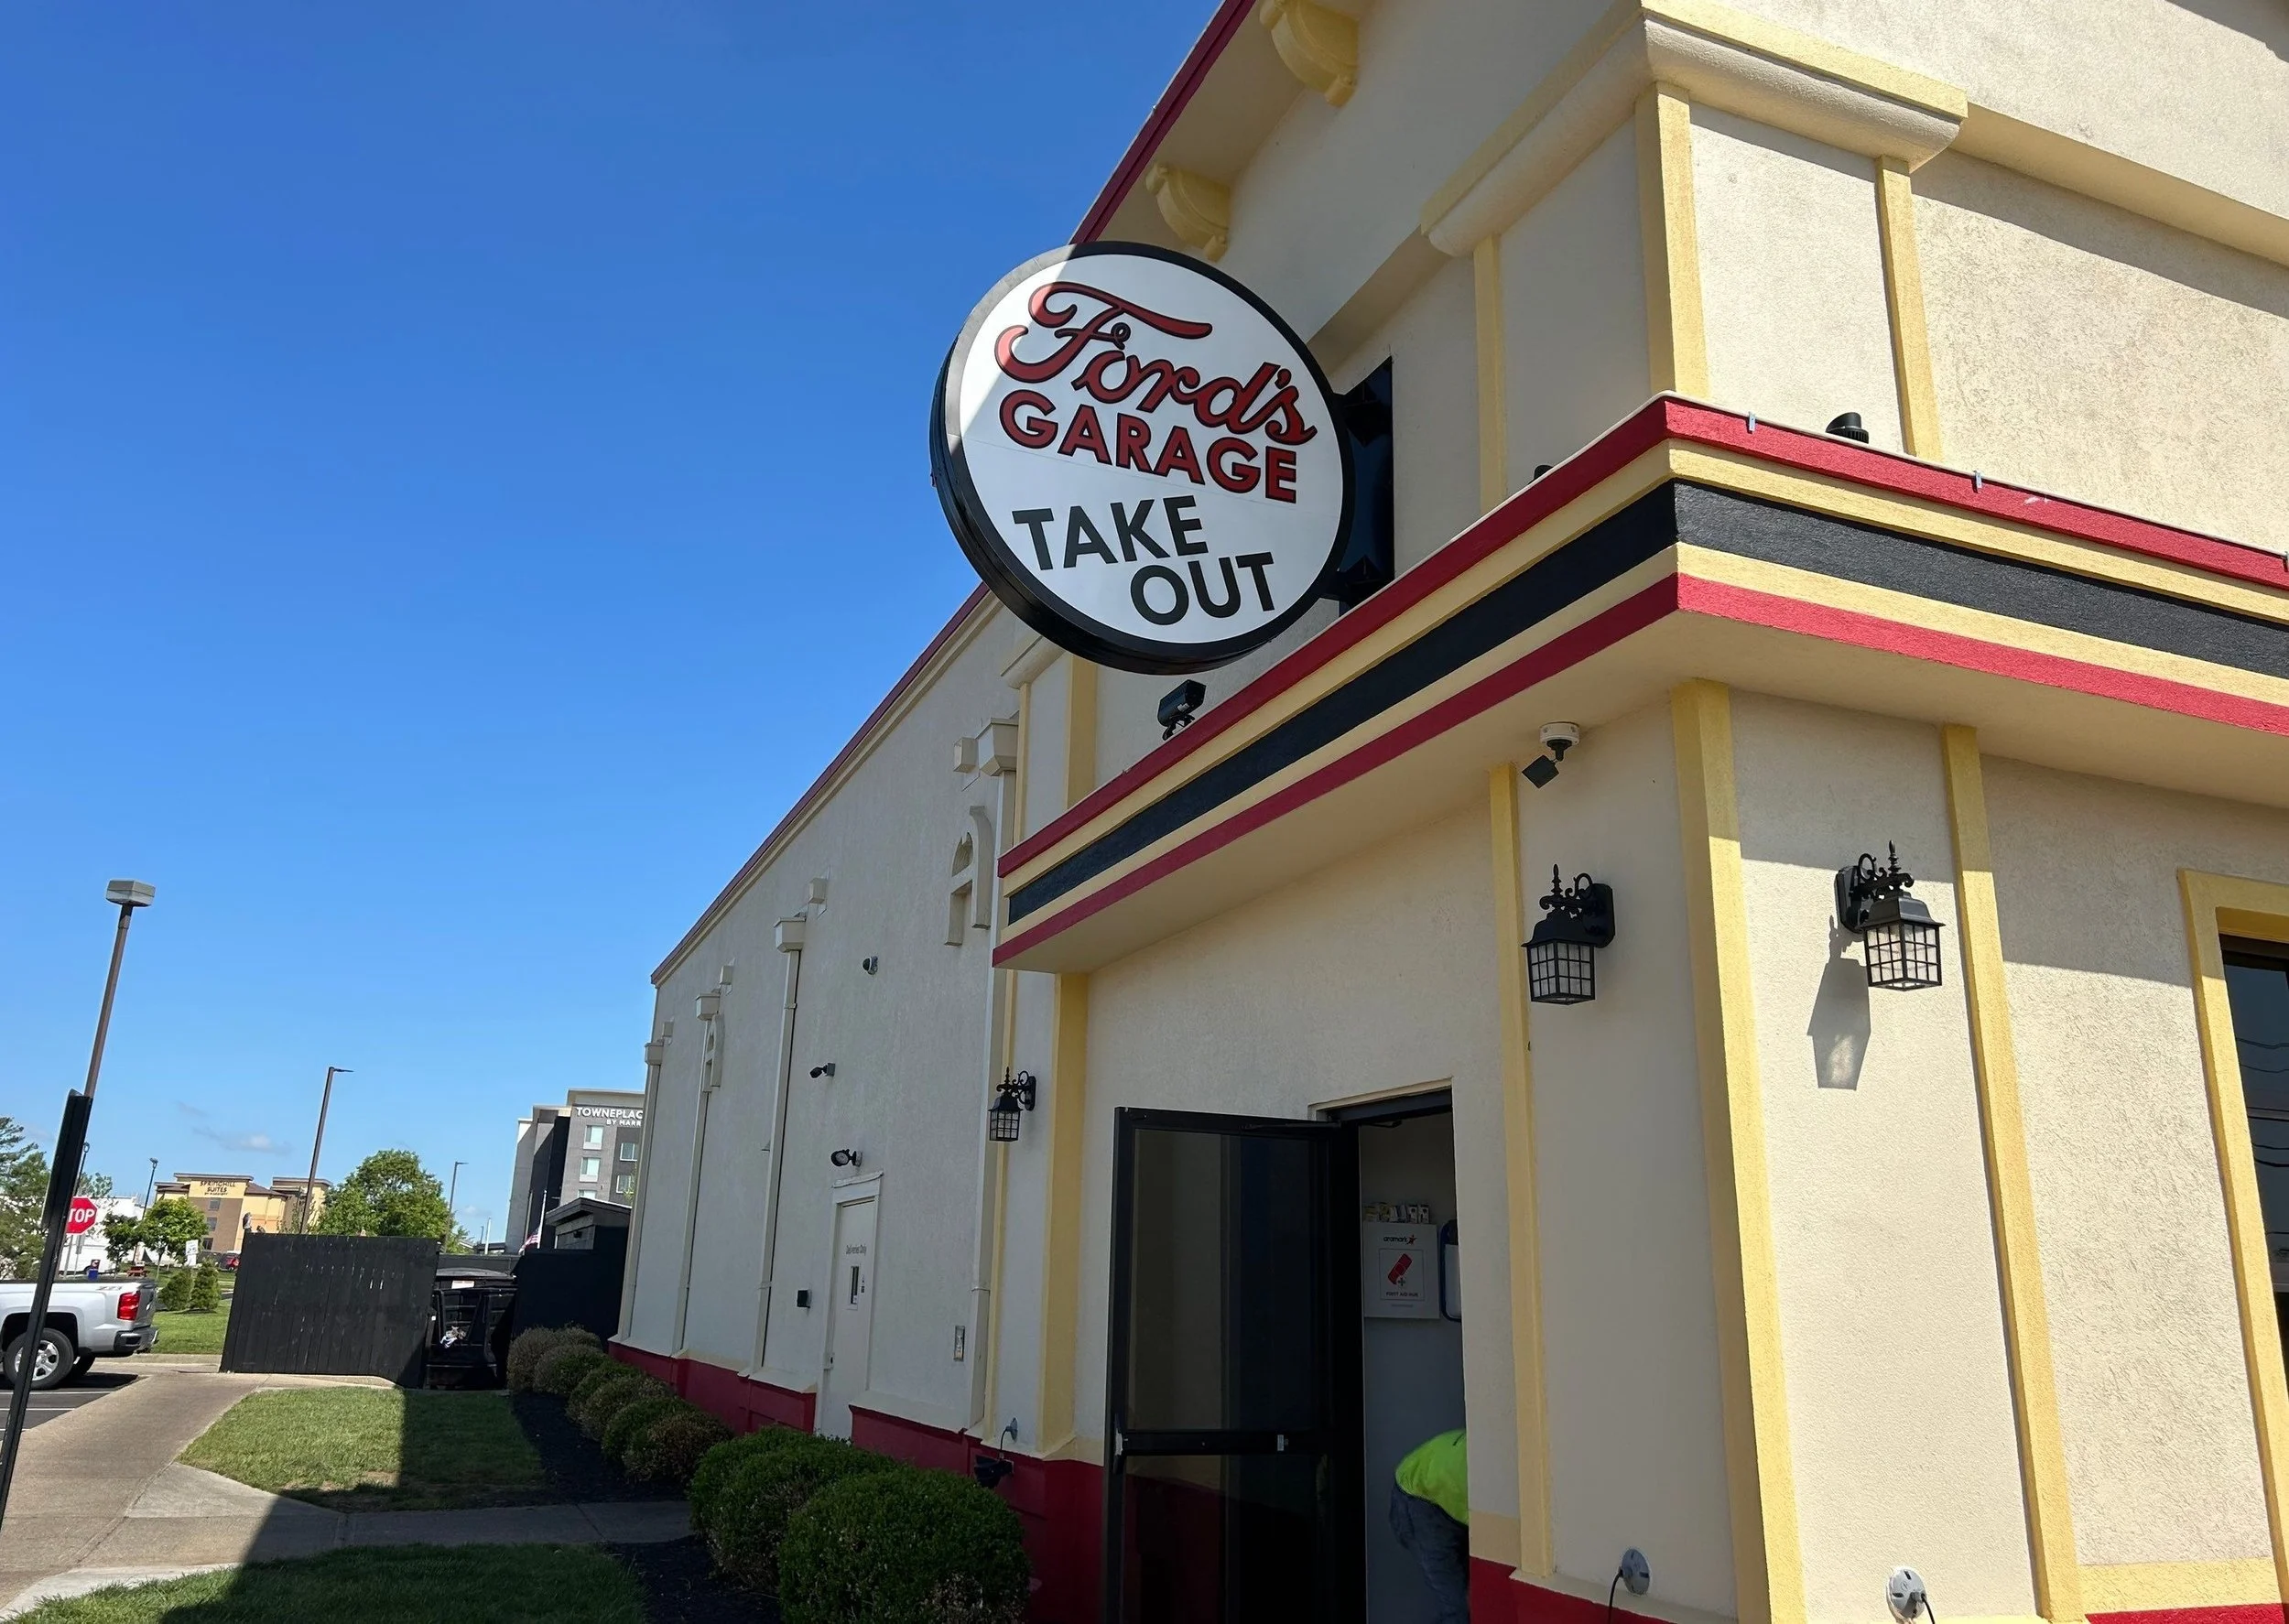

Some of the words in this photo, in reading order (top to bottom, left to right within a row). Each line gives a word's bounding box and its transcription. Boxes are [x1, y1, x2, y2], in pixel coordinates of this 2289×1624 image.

[994, 281, 1318, 446] Ford's
[999, 389, 1297, 503] GARAGE
[1012, 494, 1210, 570] TAKE
[1130, 551, 1275, 625] OUT
[576, 1107, 644, 1119] TOWNEPLAC
[69, 1208, 95, 1223] TOP
